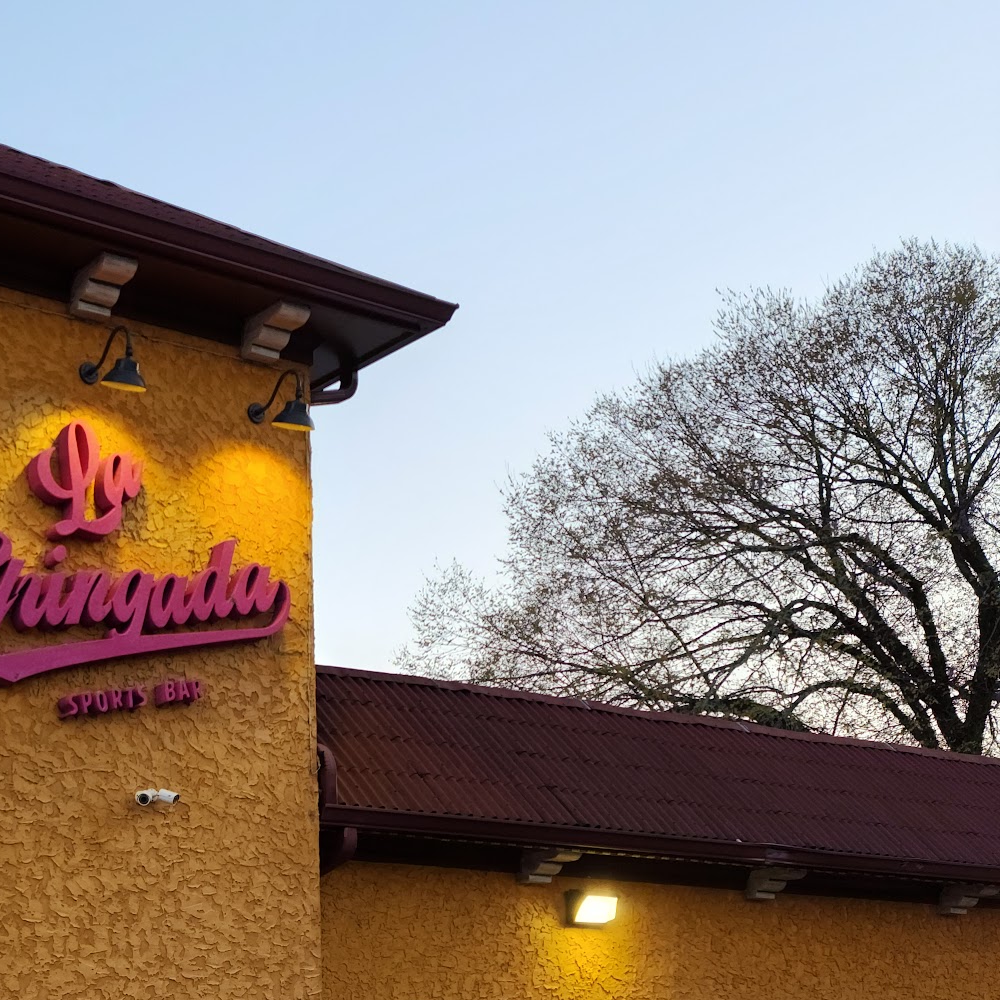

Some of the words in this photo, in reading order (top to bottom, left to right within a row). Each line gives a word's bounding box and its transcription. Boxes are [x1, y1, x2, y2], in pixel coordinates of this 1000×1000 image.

[27, 420, 143, 540] La
[58, 685, 148, 719] SPORTS
[155, 679, 203, 708] BAR
